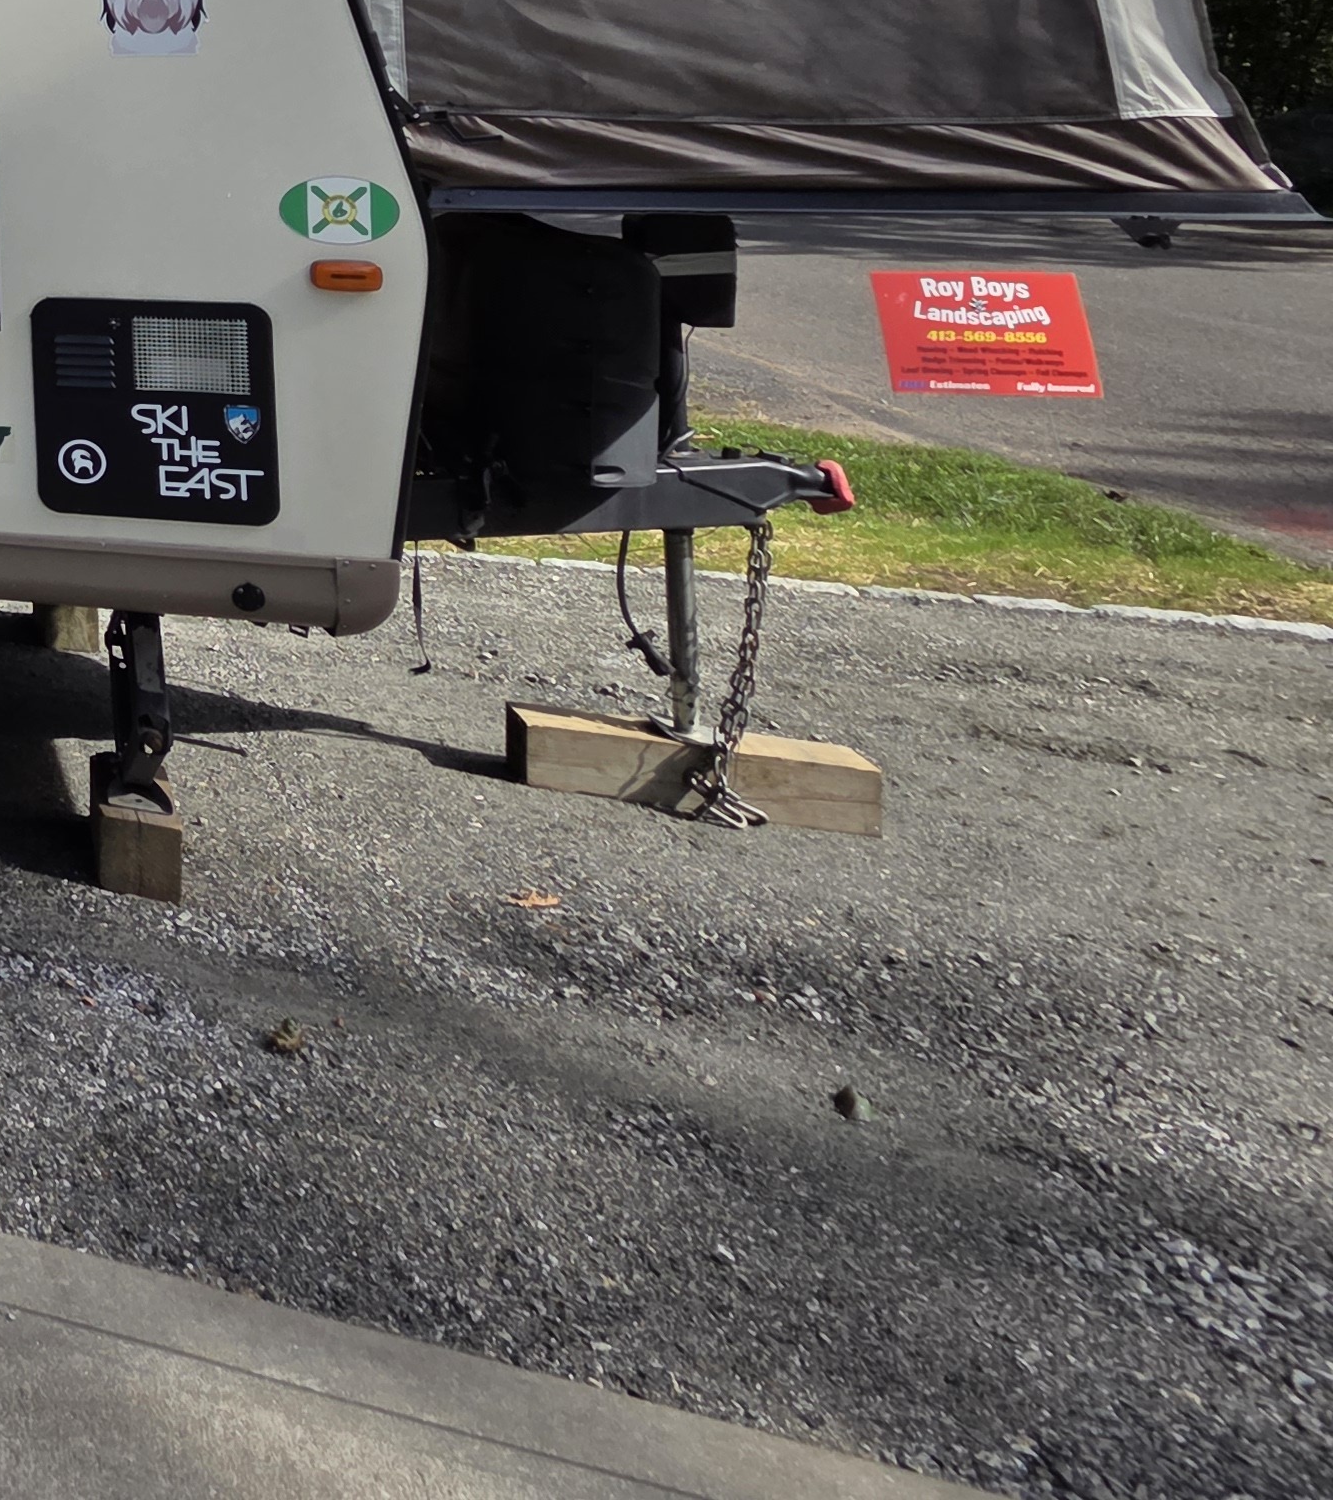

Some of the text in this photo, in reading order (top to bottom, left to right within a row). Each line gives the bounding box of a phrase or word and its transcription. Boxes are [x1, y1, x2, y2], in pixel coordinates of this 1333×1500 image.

[919, 276, 1030, 302] Roy Boys
[914, 300, 1051, 329] Landscaping
[927, 330, 1047, 343] 413-569-8556
[131, 403, 189, 435] SKI
[150, 436, 222, 467] THE
[158, 465, 265, 501] EAST
